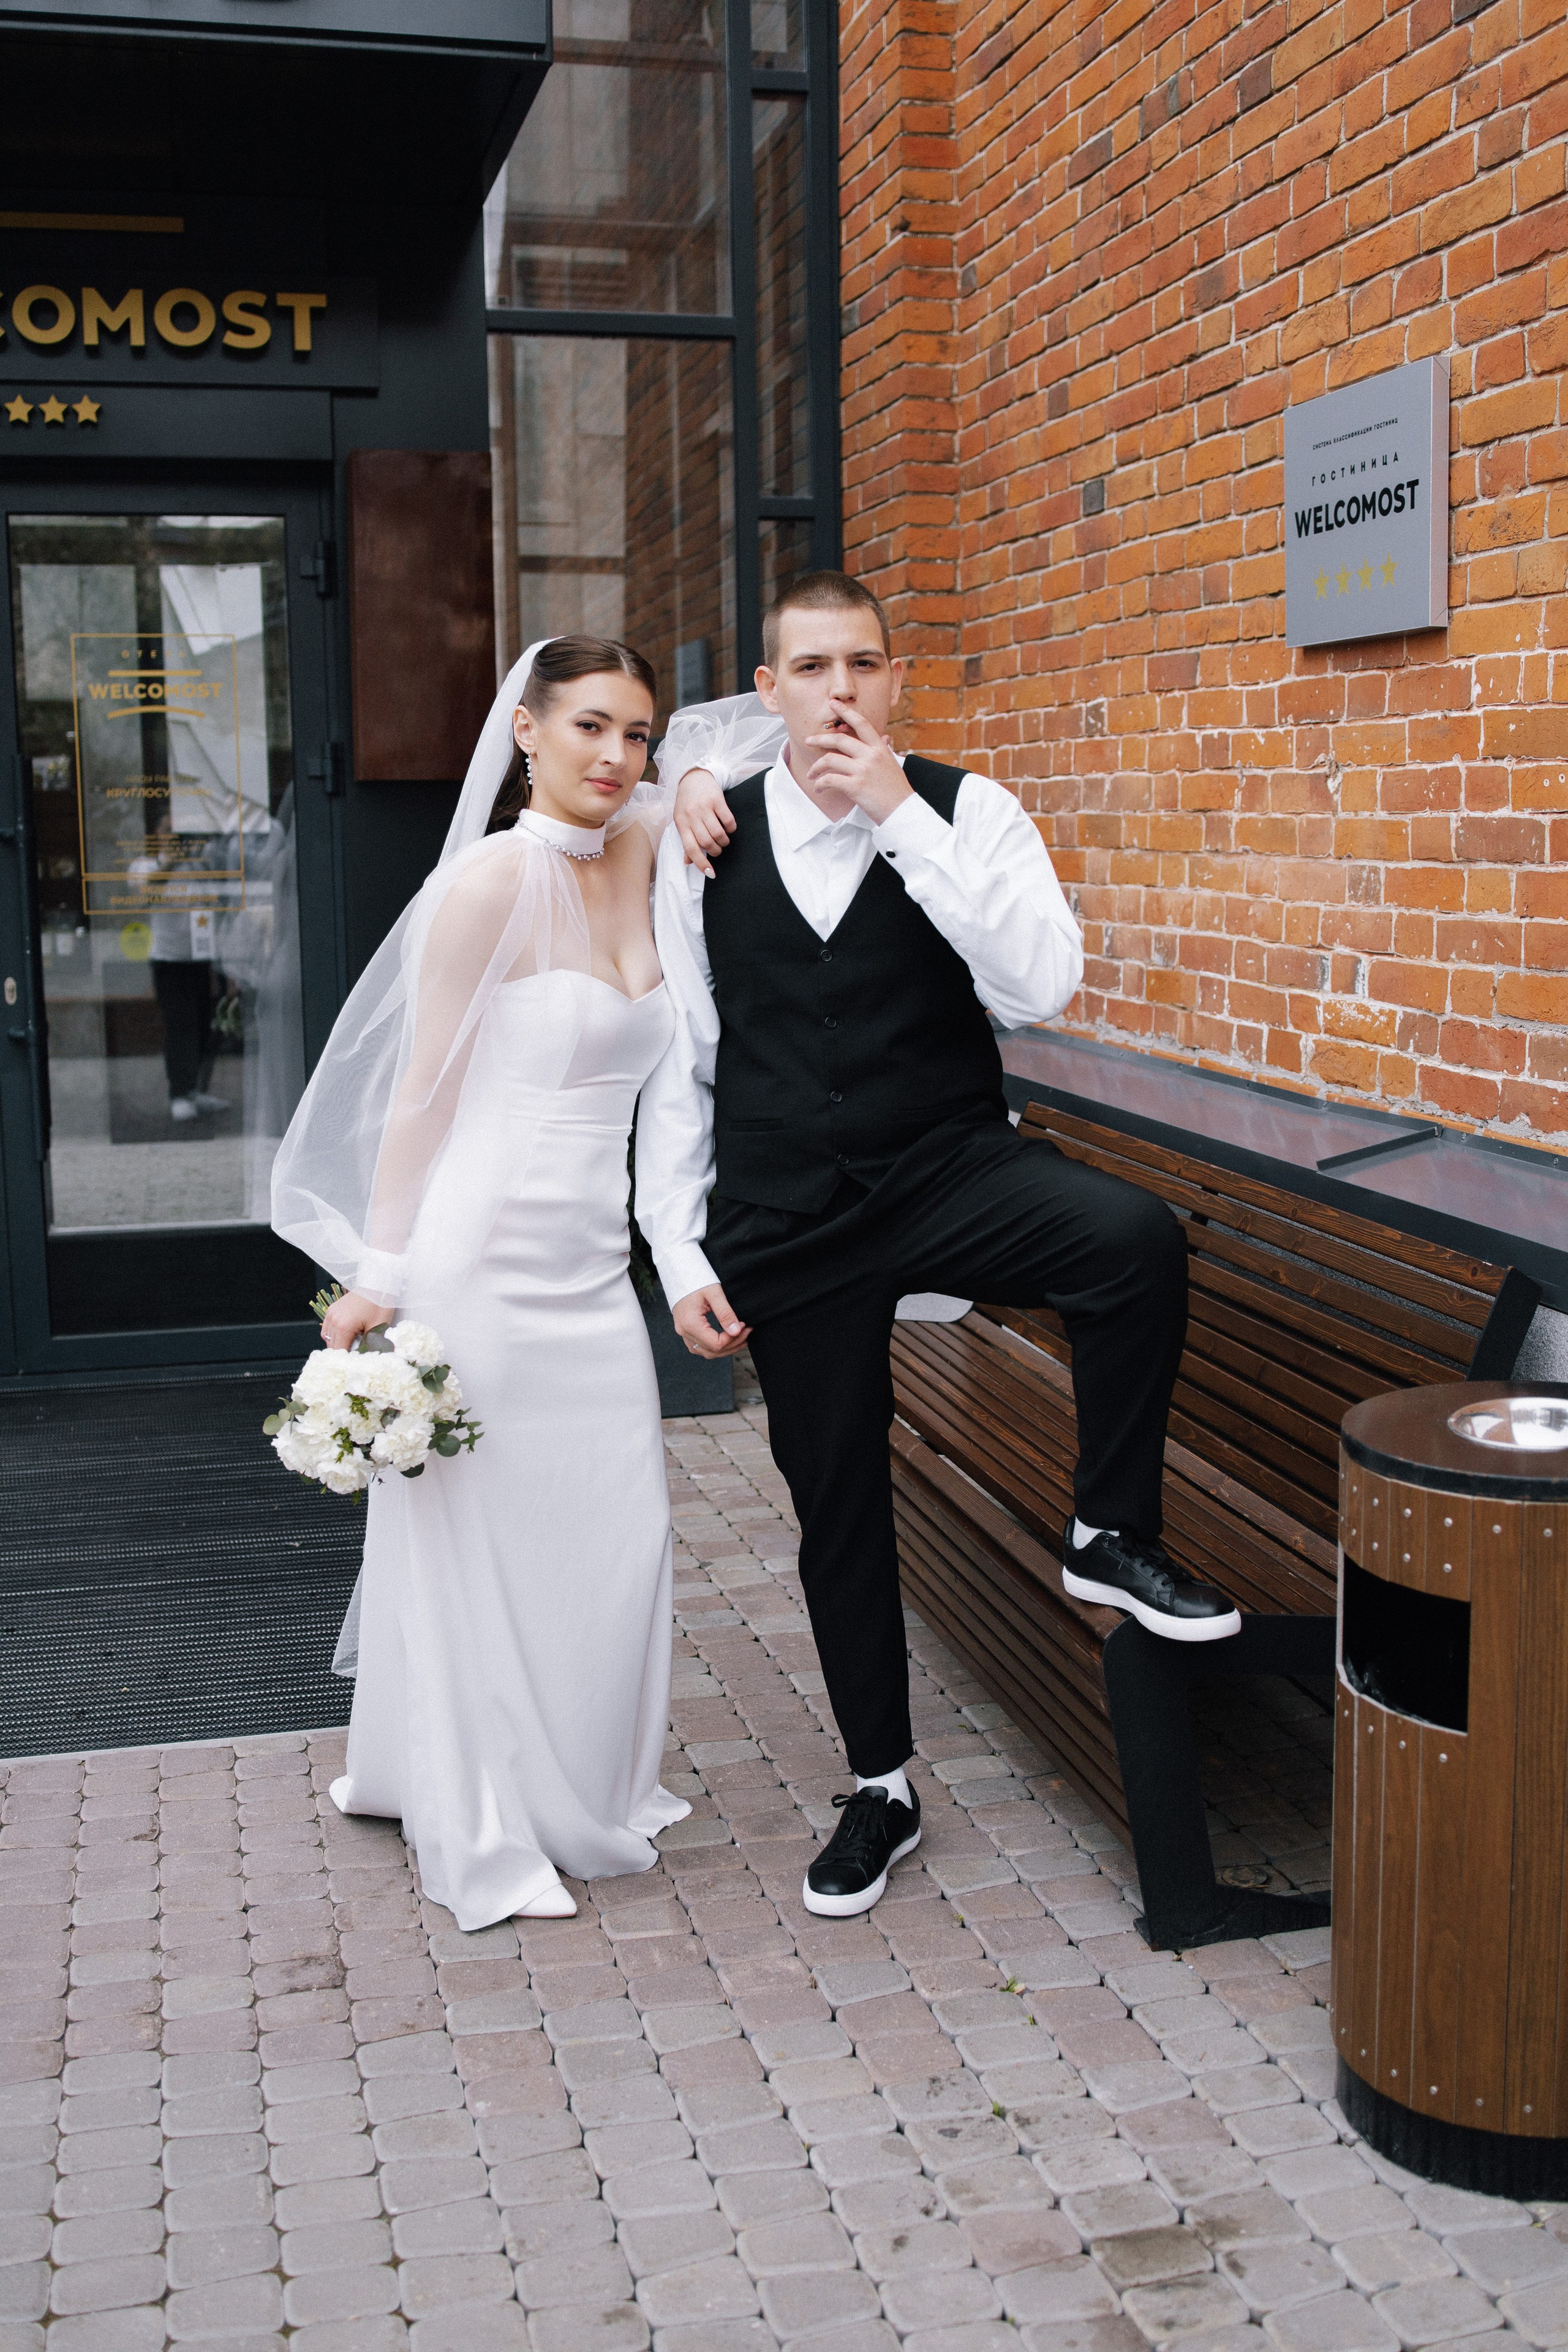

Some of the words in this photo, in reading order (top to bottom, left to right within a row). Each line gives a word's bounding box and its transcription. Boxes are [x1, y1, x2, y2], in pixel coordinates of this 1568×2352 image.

[0, 284, 327, 351] OMOST
[1374, 417, 1398, 430] ГОСТИНИЦ
[1312, 452, 1398, 486] ГОСТИНИЦА
[1294, 479, 1419, 538] WELCOMOST
[88, 682, 222, 699] WELCOMOST
